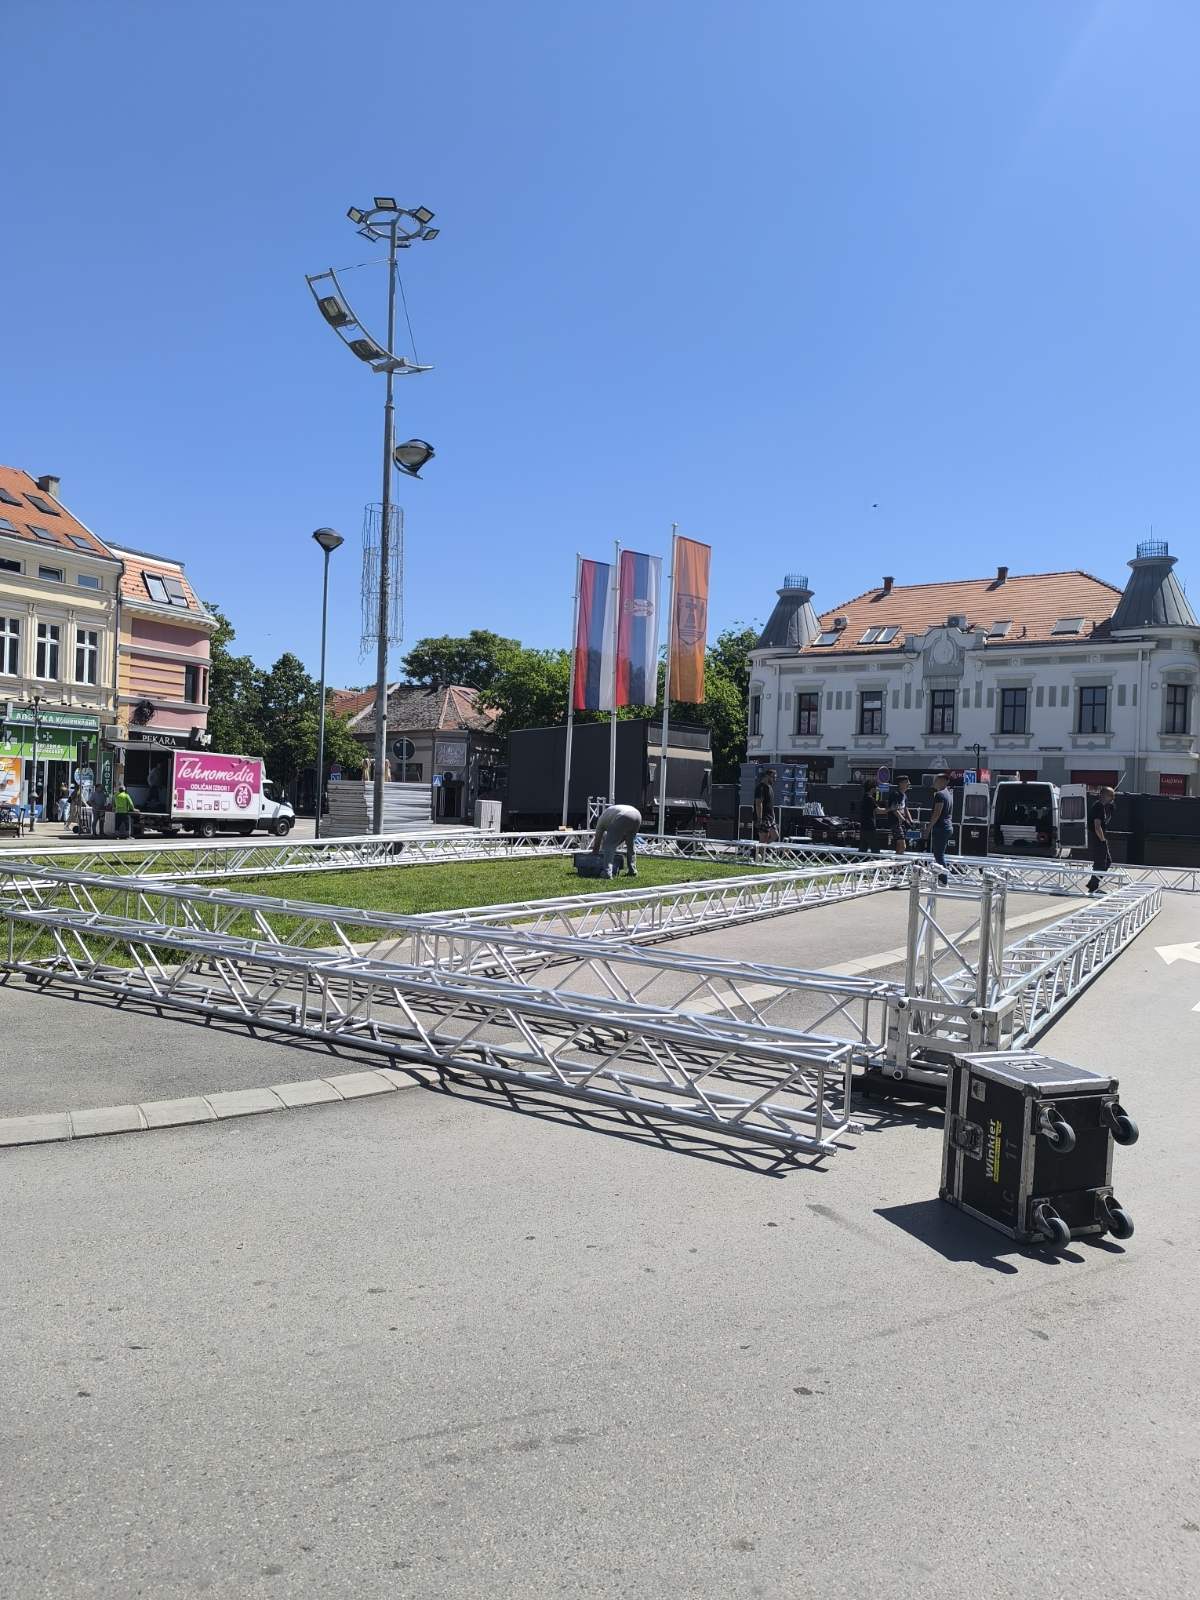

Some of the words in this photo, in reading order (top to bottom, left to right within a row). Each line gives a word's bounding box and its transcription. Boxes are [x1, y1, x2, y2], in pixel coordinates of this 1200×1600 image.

[16, 713, 54, 723] АПОЕКА
[142, 735, 176, 746] PEKARA
[177, 757, 254, 783] Tehnomedia
